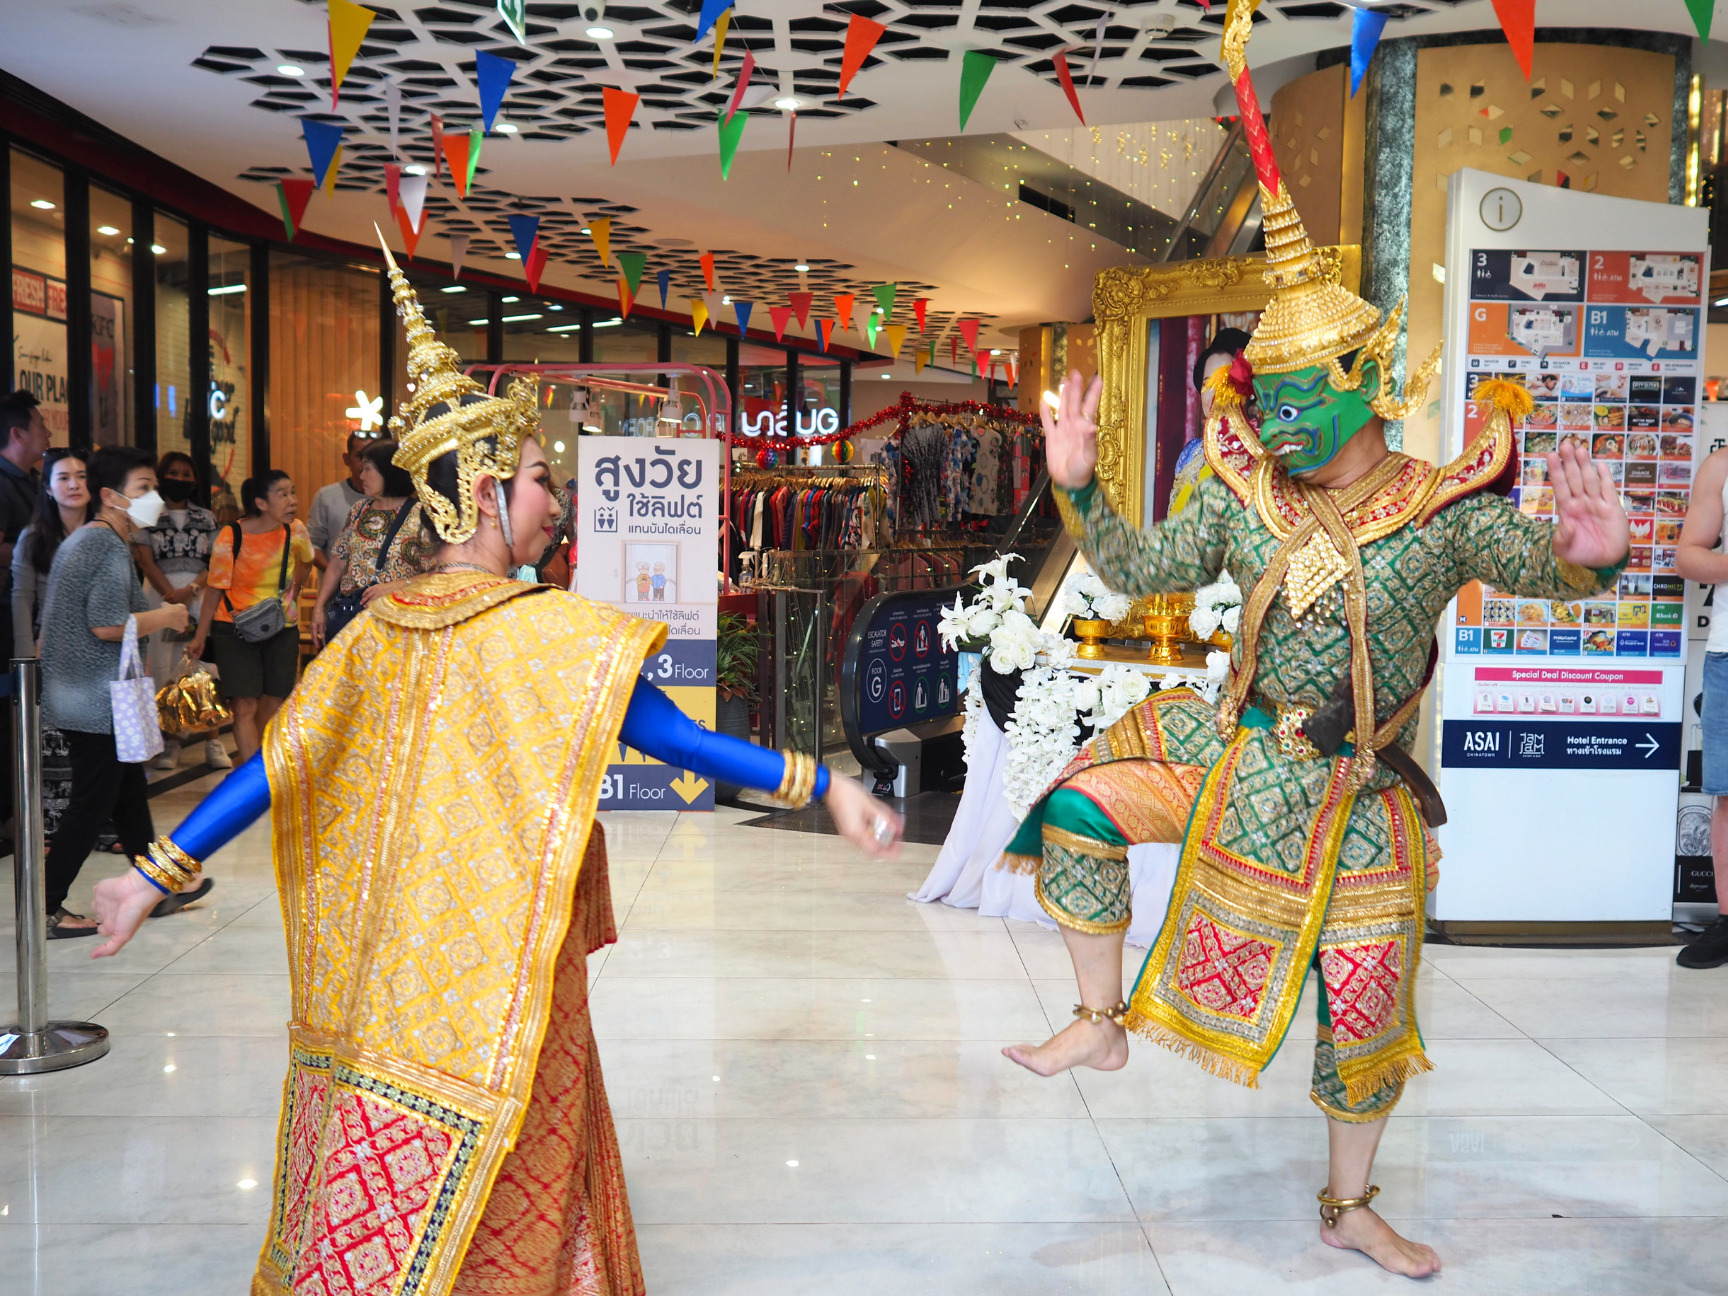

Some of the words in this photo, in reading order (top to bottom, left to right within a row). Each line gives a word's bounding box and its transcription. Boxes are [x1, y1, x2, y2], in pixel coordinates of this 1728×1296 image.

[1477, 253, 1487, 266] 3
[1594, 256, 1605, 269] 2
[1609, 274, 1622, 282] ATM
[1475, 308, 1487, 322] G
[1591, 311, 1607, 325] B1
[20, 369, 44, 401] OUR
[1467, 405, 1478, 418] 2
[595, 445, 702, 502] สูงวัย
[627, 492, 703, 518] ใช้ลิฟต์
[628, 520, 702, 534] แทนบันไดเลื่อน
[1458, 629, 1474, 641] B1
[870, 639, 884, 648] SAFETY
[657, 654, 673, 679] 3
[675, 663, 710, 679] Floor
[1512, 670, 1541, 680] Special
[1541, 671, 1560, 679] Deal
[1561, 671, 1593, 680] Discount
[1594, 671, 1624, 682] Coupon
[871, 676, 882, 697] G
[1463, 731, 1500, 751] ASAI
[1567, 736, 1590, 745] Hotel
[1591, 736, 1628, 745] Entrance
[1566, 746, 1622, 755] ทางเข้าโรงแรม
[599, 774, 624, 800] B1
[629, 783, 666, 800] Floor
